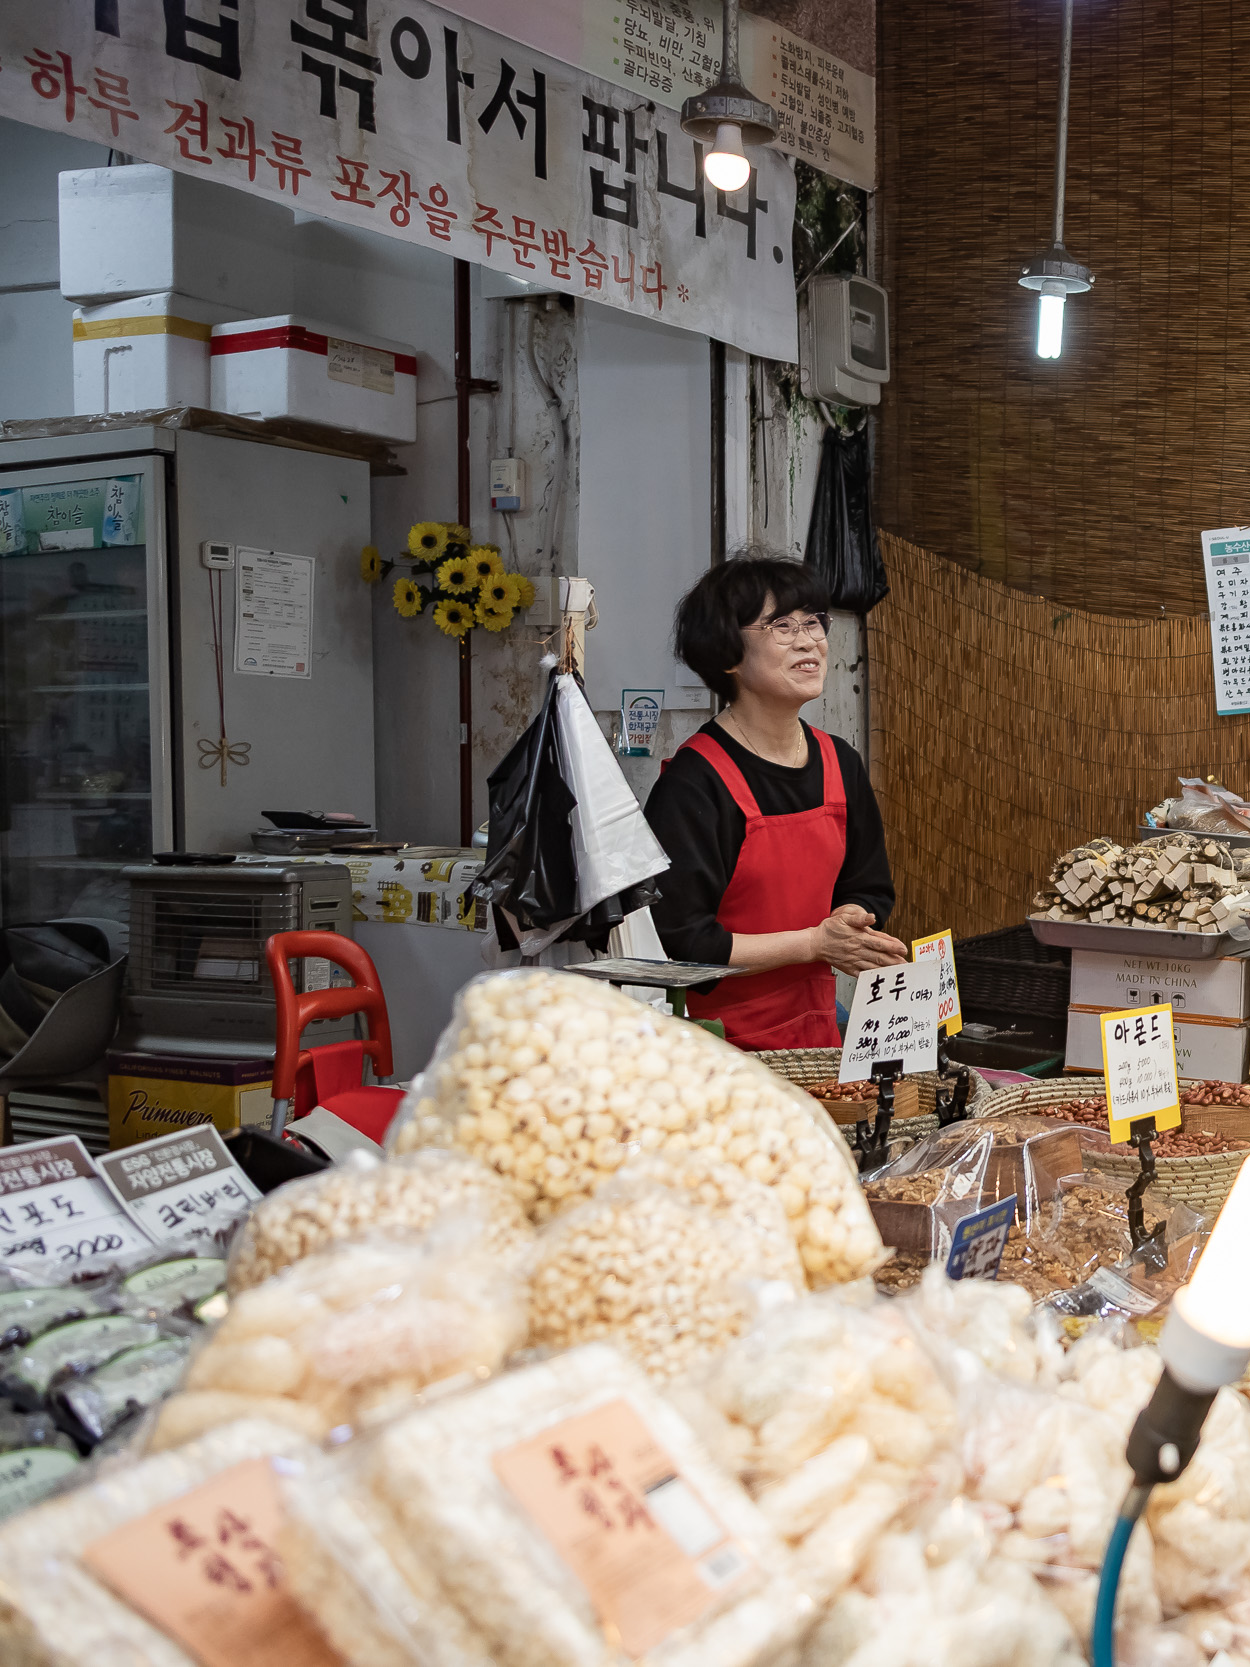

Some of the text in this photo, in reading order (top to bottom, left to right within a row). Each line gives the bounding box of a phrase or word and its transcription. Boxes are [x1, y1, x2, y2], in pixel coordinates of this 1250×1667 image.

[624, 18, 652, 46] 당뇨,
[659, 35, 684, 61] 비만,
[684, 26, 707, 48] 기침
[623, 58, 673, 93] 골다공증
[24, 47, 139, 137] 하루
[164, 99, 311, 196] 견과류
[330, 155, 458, 241] 포장을
[800, 119, 832, 146] 불안증상
[47, 504, 85, 526] 참이슬
[107, 484, 124, 532] 참이슬
[1217, 577, 1249, 588] 오미자
[1218, 589, 1249, 599] 구기자
[628, 710, 659, 722] 전통시장
[1123, 959, 1142, 970] NET
[866, 971, 907, 1006] 호두
[1115, 973, 1198, 989] MADE IN CHINA
[1114, 1014, 1162, 1047] 아몬드
[122, 1089, 216, 1126] Primavera
[119, 1153, 151, 1173] ESG
[127, 1147, 218, 1190] 자양전통시장
